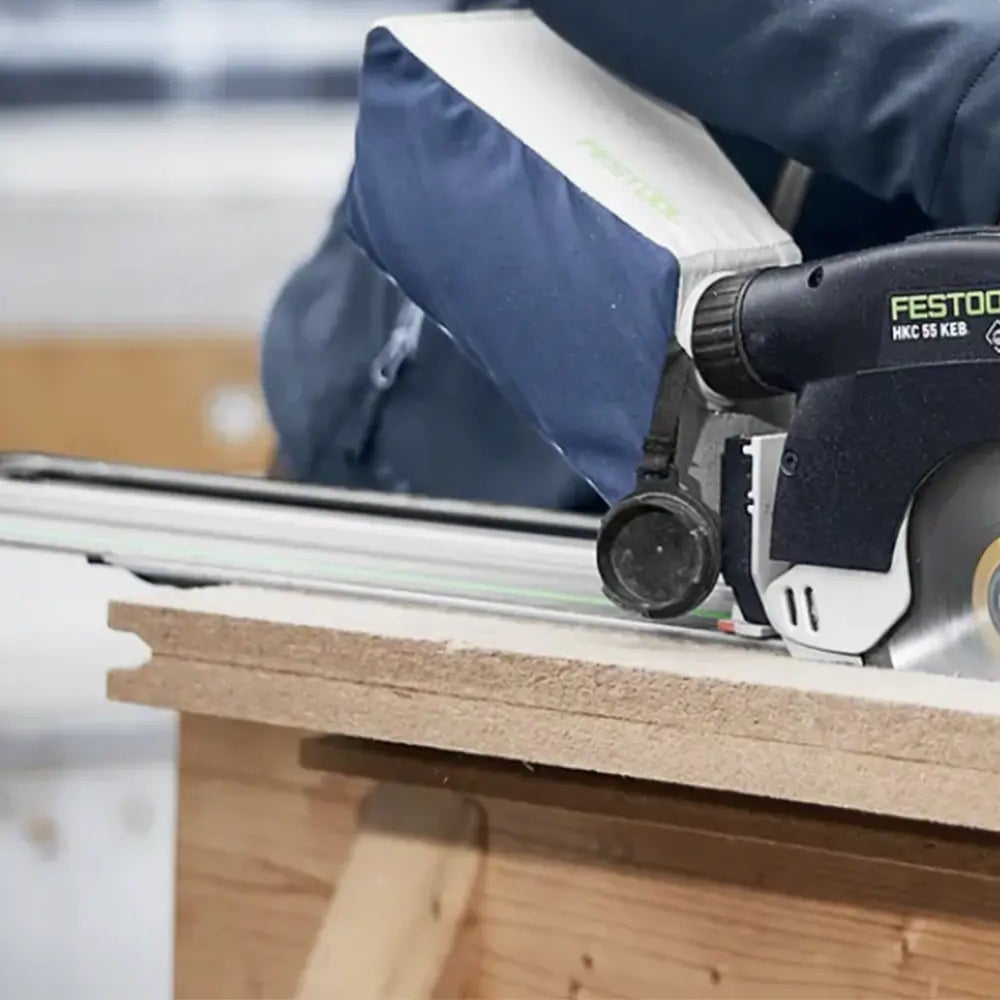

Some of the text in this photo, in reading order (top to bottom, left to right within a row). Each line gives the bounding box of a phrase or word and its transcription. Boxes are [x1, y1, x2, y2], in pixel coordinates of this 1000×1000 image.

[892, 321, 968, 341] HKC 55 KEB
